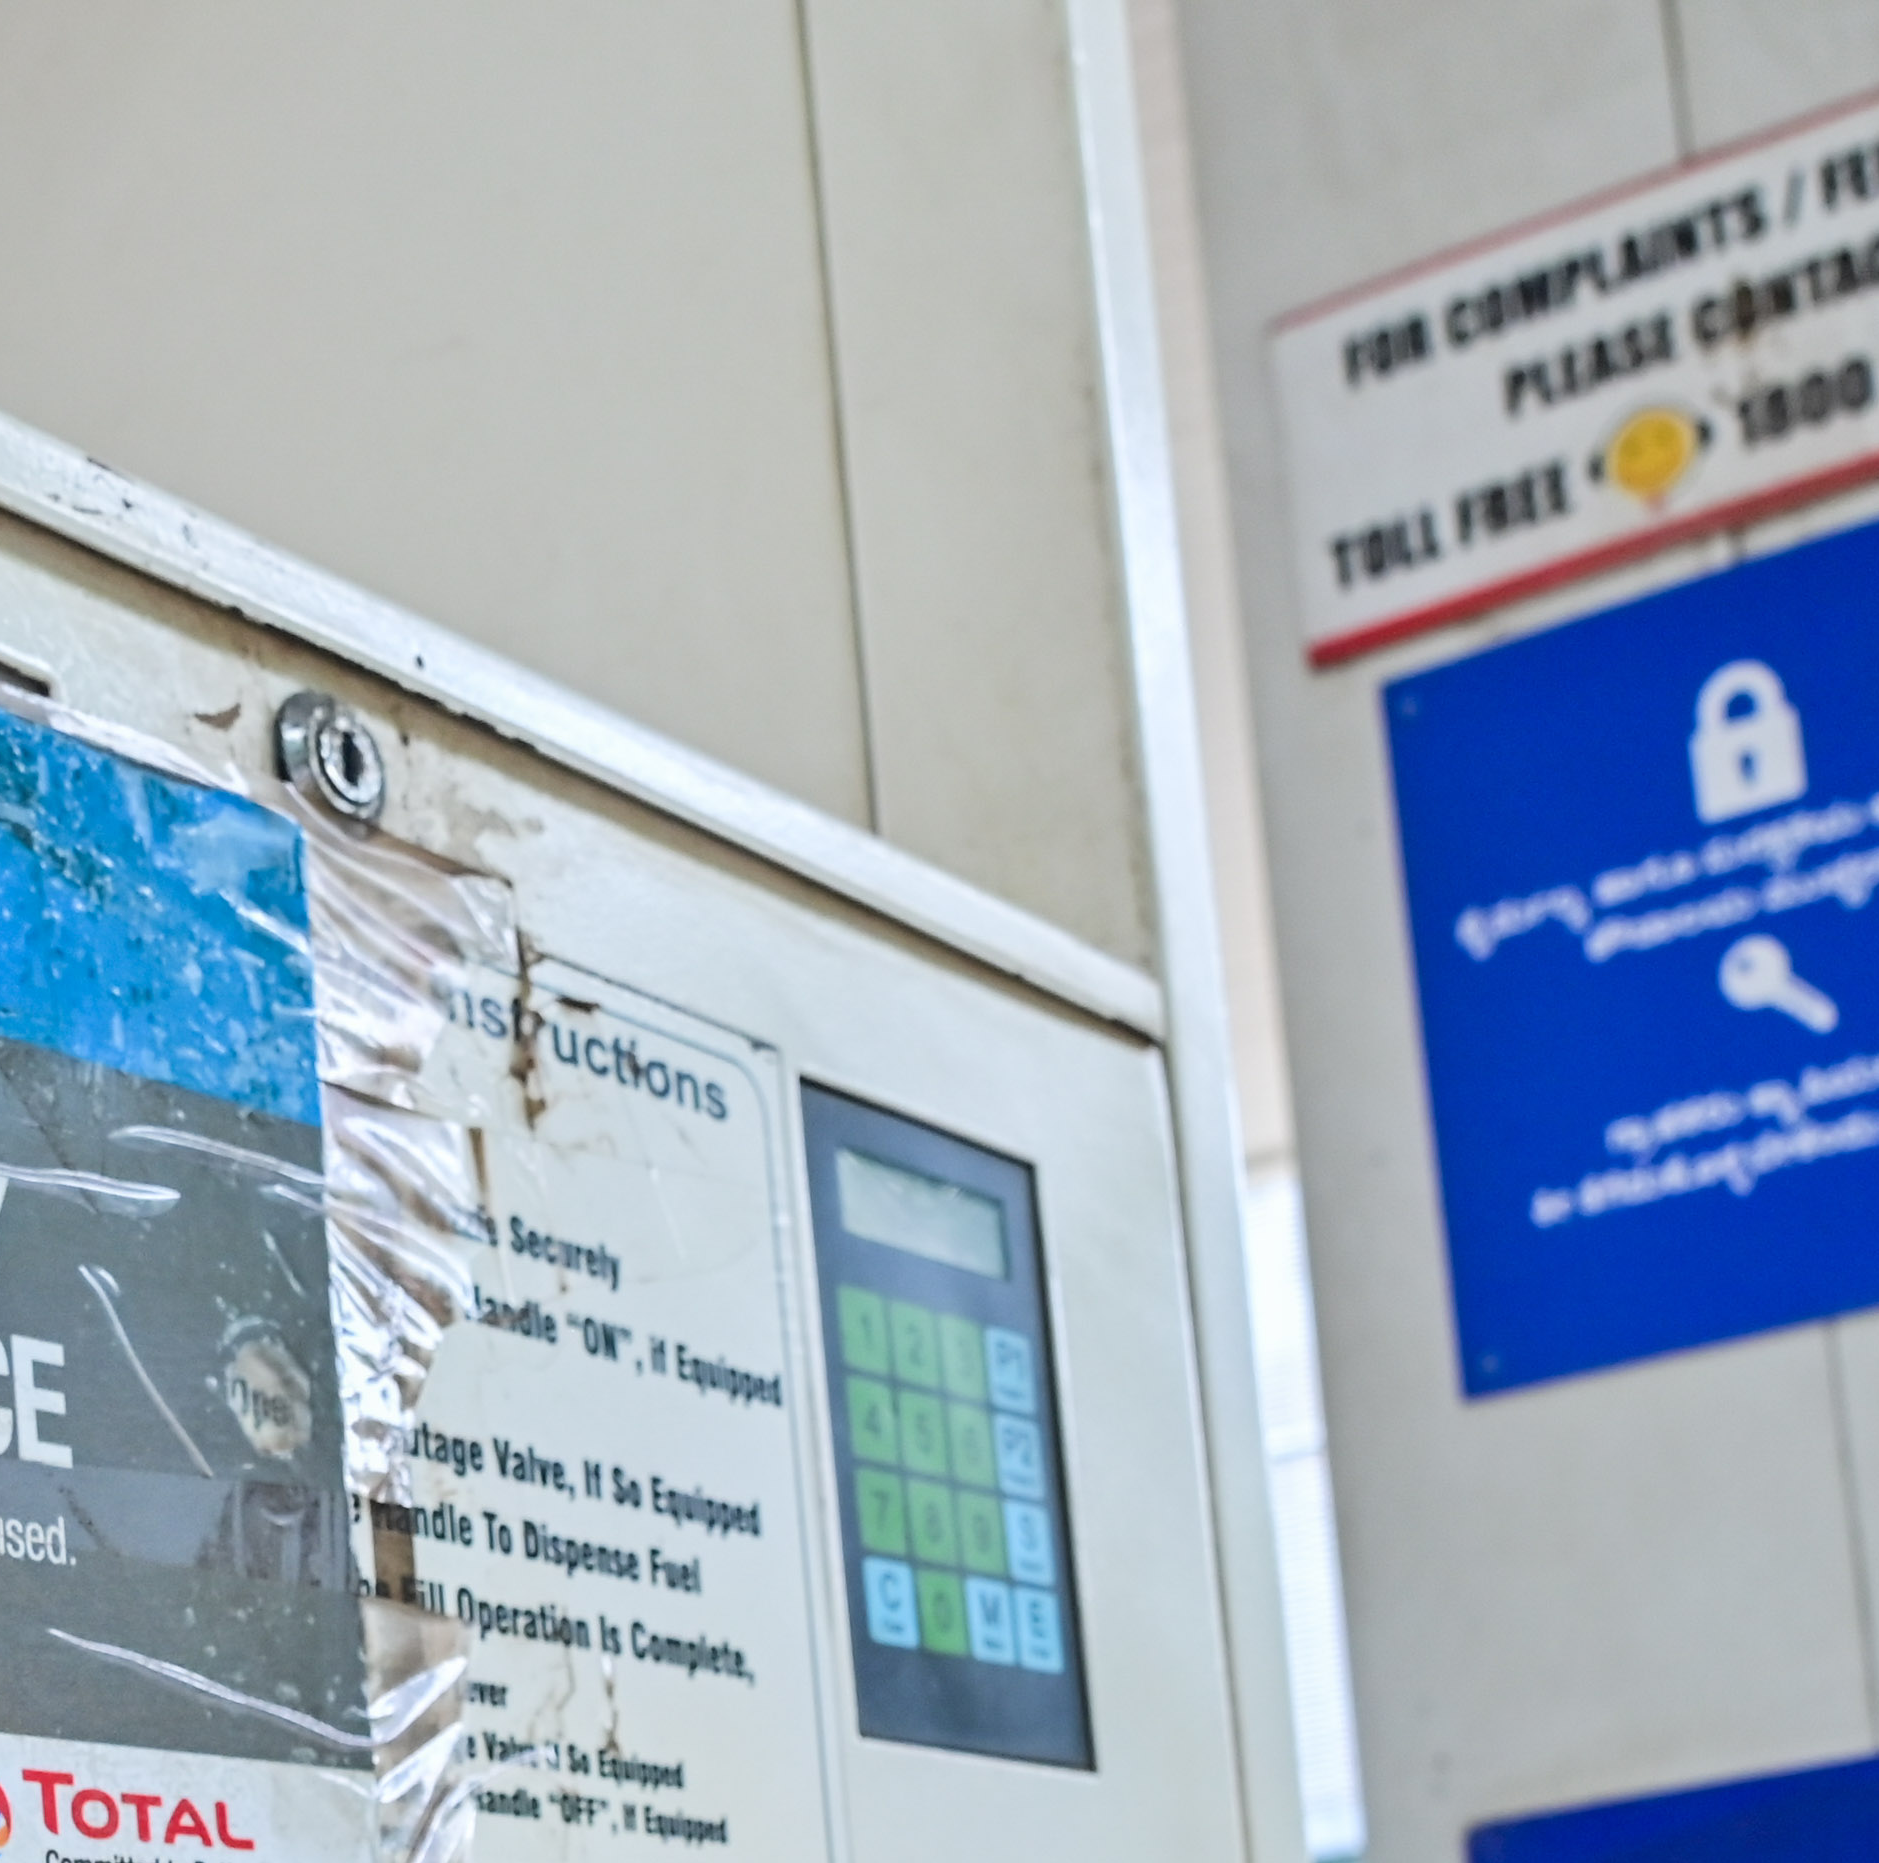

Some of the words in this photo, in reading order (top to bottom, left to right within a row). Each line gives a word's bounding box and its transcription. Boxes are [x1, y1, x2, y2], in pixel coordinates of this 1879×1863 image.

[1340, 307, 1434, 391] FOR
[1444, 178, 1770, 351] COMPLAINTS
[1504, 311, 1676, 417] PLEASE
[1328, 503, 1443, 592] TOLL
[1456, 455, 1577, 548] FREE
[1735, 355, 1876, 450] 1800
[510, 1215, 620, 1292] Securely
[676, 1342, 783, 1407] Equipped
[403, 1421, 483, 1477] utage
[493, 1436, 575, 1501] Valve,
[584, 1459, 603, 1498] If
[612, 1465, 641, 1507] So
[651, 1475, 762, 1540] Equipped
[482, 1509, 513, 1555] To
[524, 1519, 640, 1581] Dispense
[649, 1547, 703, 1594] Fuel
[457, 1586, 590, 1648] Operation
[600, 1615, 623, 1656] Is
[631, 1620, 755, 1685] Complete,
[567, 1743, 590, 1776] So
[599, 1747, 685, 1790] Equipped
[22, 1768, 255, 1851] TOTAL
[644, 1804, 728, 1848] Equipped
